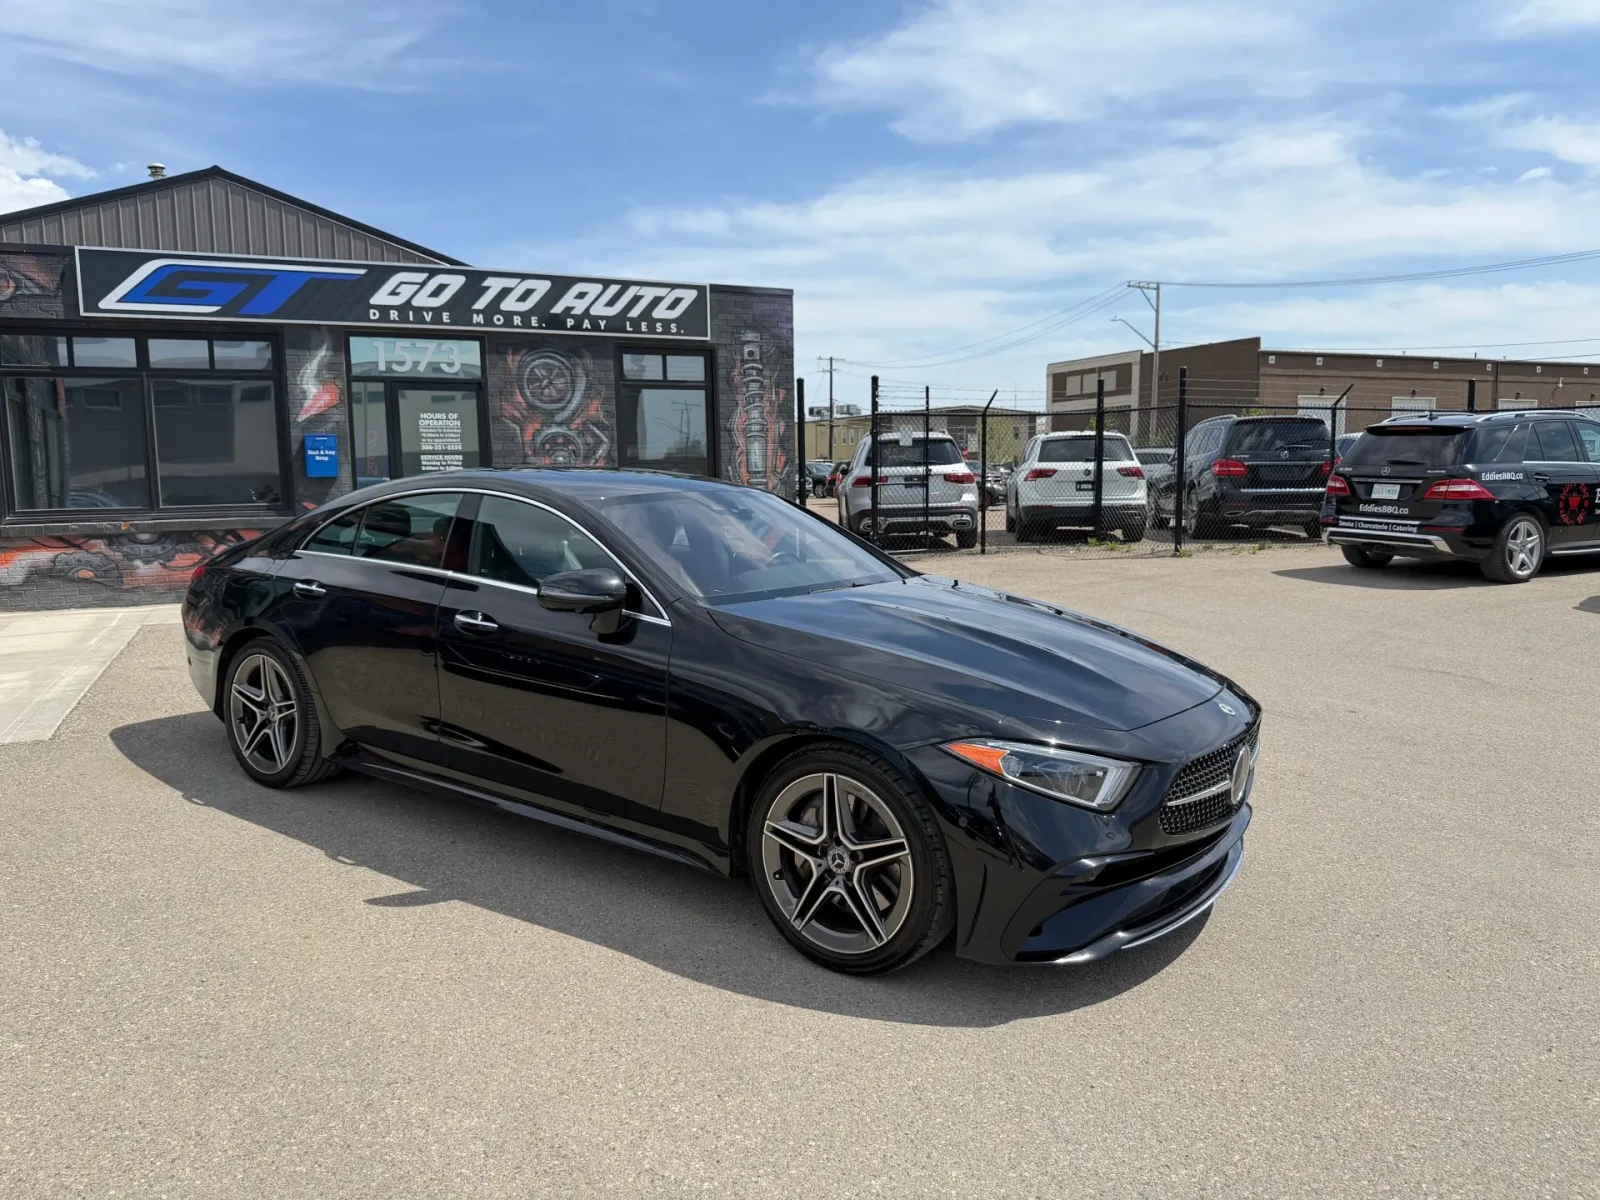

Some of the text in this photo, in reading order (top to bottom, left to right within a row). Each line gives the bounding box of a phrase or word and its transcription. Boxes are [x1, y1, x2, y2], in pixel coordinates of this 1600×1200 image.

[369, 272, 698, 319] GO TO AUTO
[369, 309, 685, 334] DRIVE MORE. PAY LESS.
[373, 340, 461, 374] 1573
[1359, 503, 1409, 514] EddiesBBQ.ca
[1338, 520, 1355, 528] Smoke
[1358, 521, 1388, 530] Charcuterie
[1392, 524, 1418, 533] Catering
